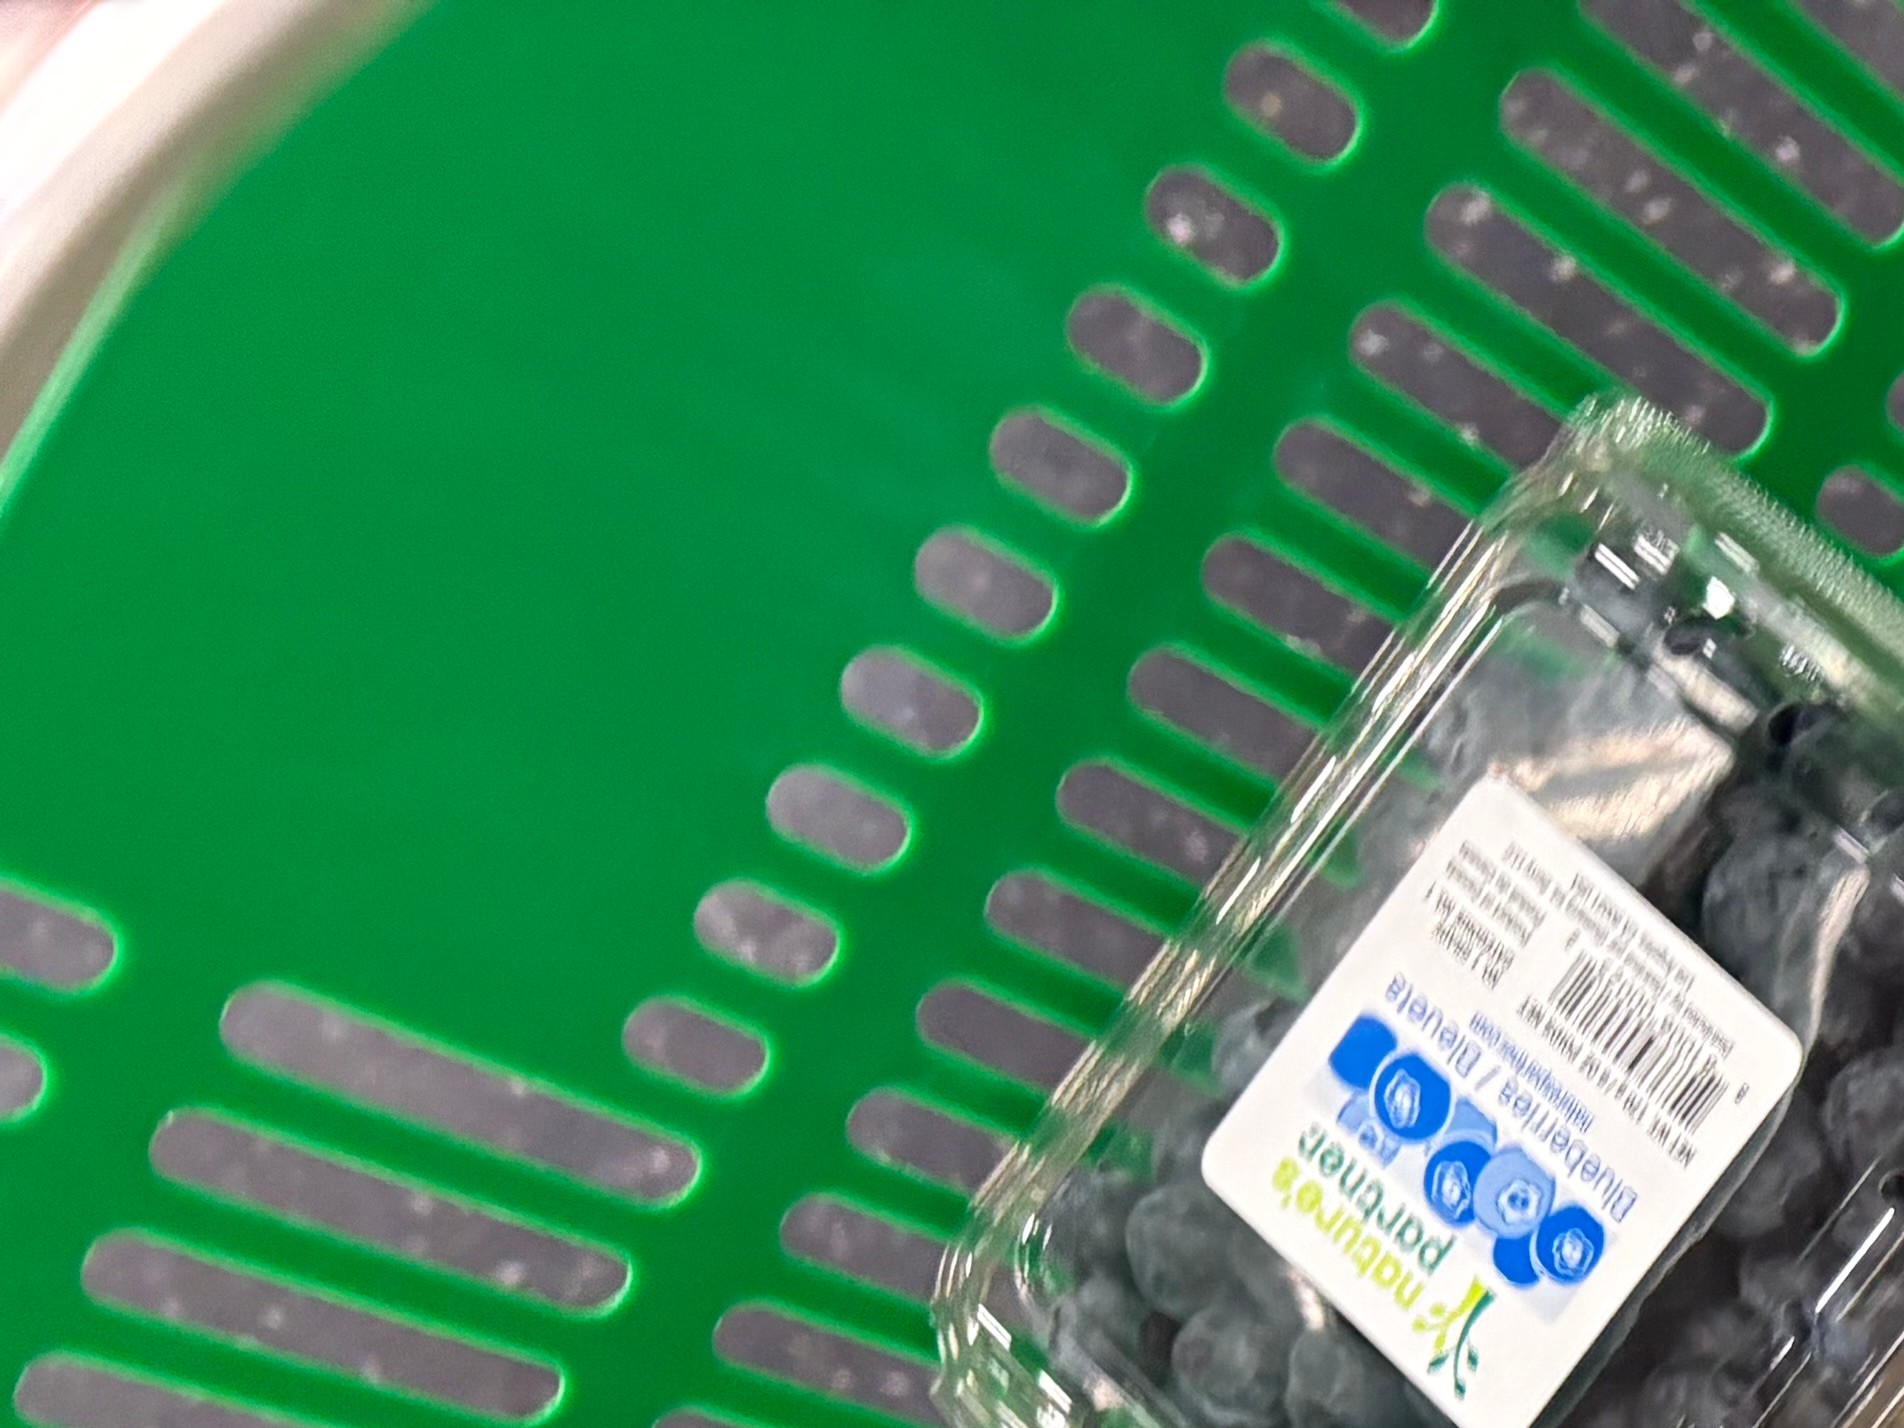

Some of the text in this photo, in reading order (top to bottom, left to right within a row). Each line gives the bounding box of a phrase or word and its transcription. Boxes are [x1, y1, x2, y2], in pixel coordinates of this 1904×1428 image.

[1385, 976, 1481, 1078] Bleuets
[1498, 1080, 1638, 1223] Blueberries
[1273, 1158, 1423, 1310] nature's
